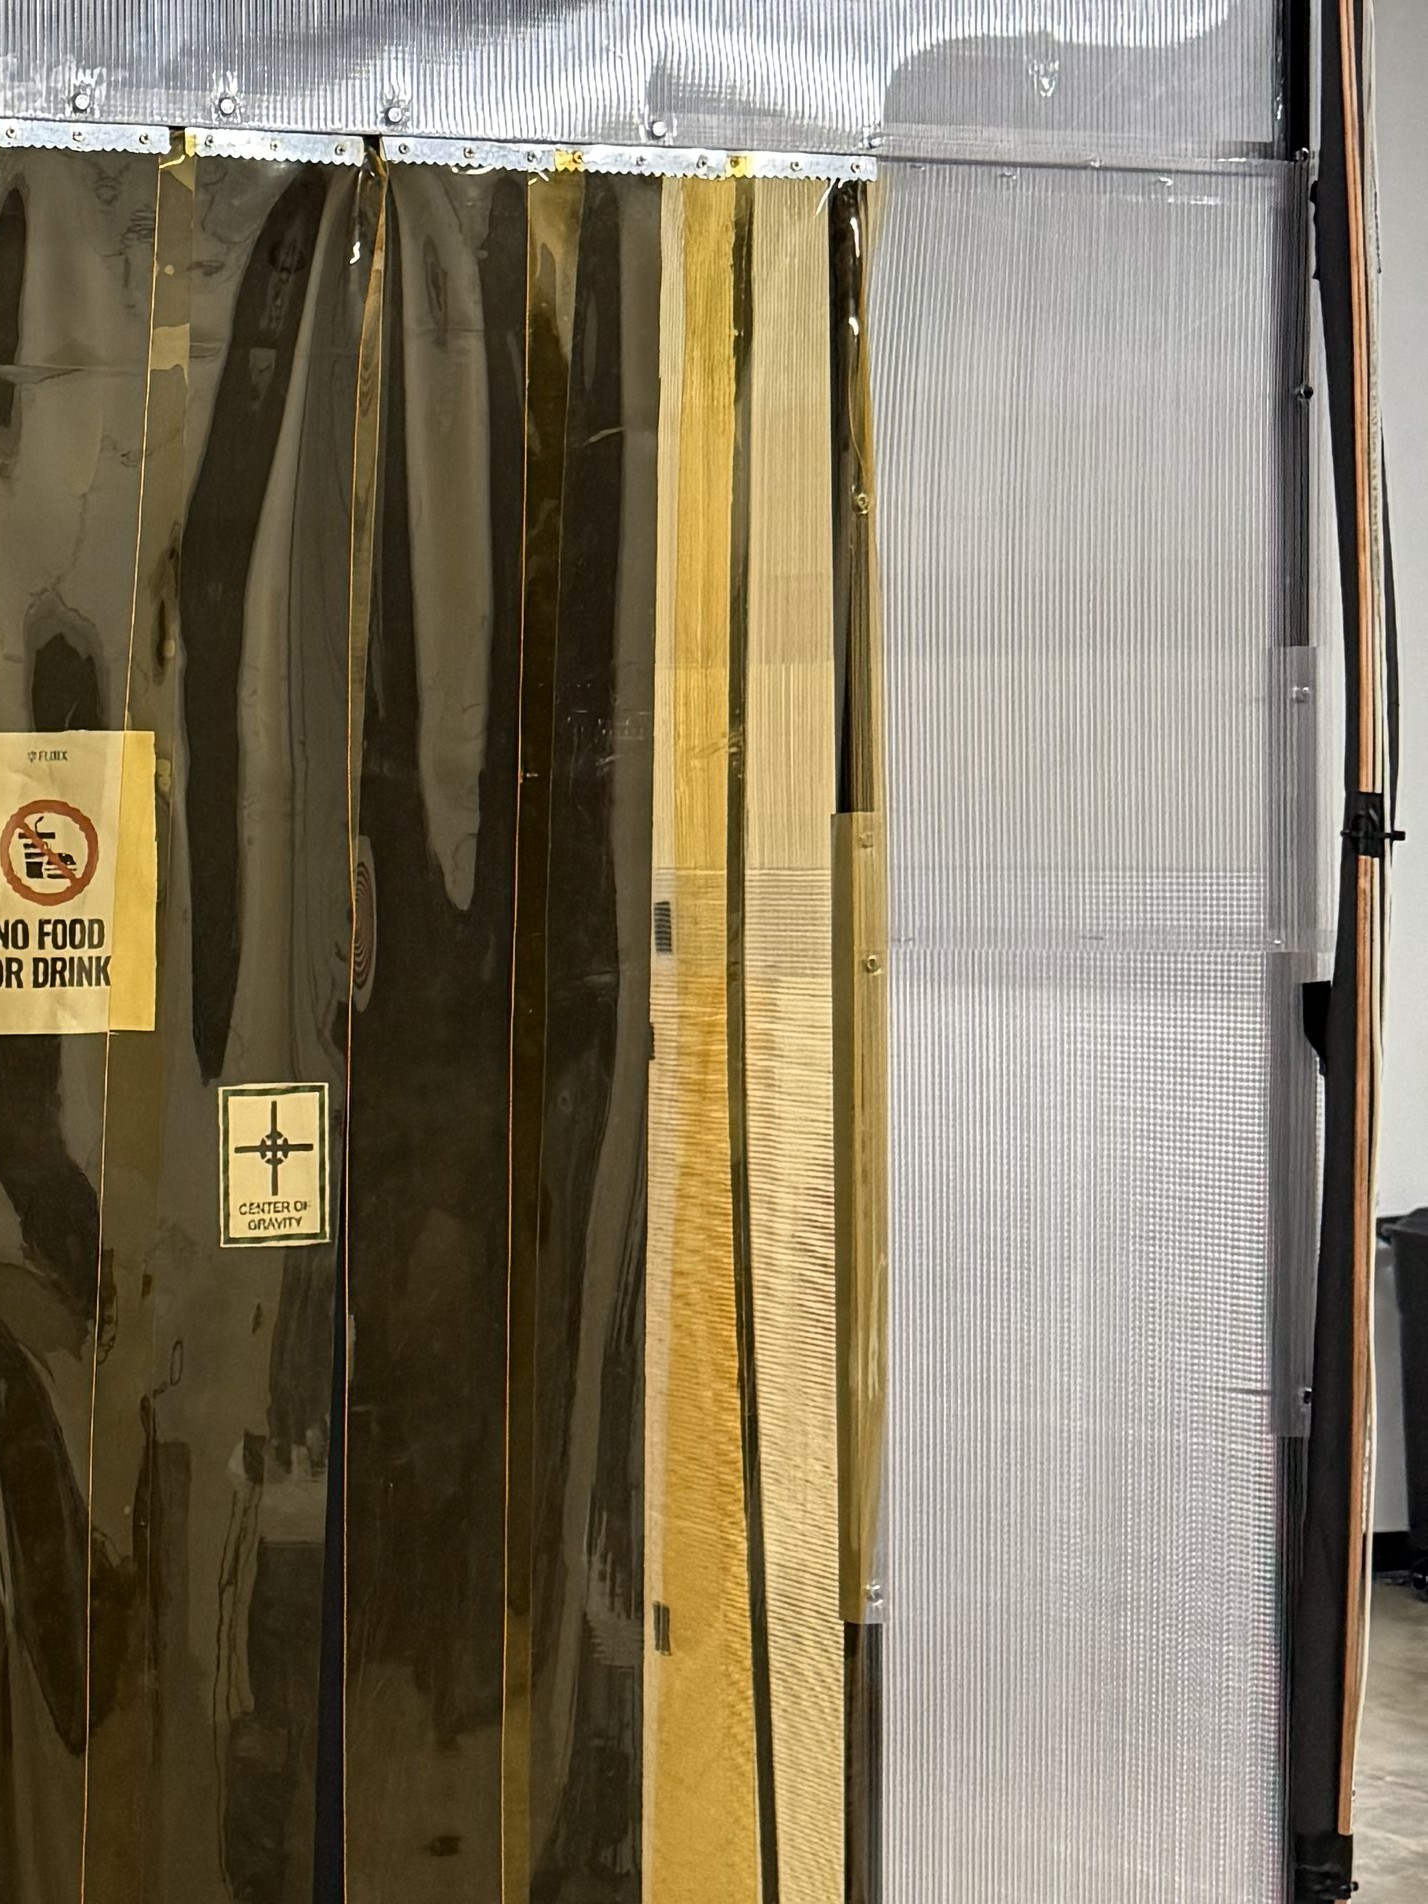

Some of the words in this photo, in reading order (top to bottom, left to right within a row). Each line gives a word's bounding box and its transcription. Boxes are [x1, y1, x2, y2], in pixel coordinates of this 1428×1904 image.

[37, 918, 105, 950] FOOD
[32, 955, 112, 988] DRINK
[238, 1200, 291, 1215] CENTER
[247, 1216, 303, 1230] GRAVITY
